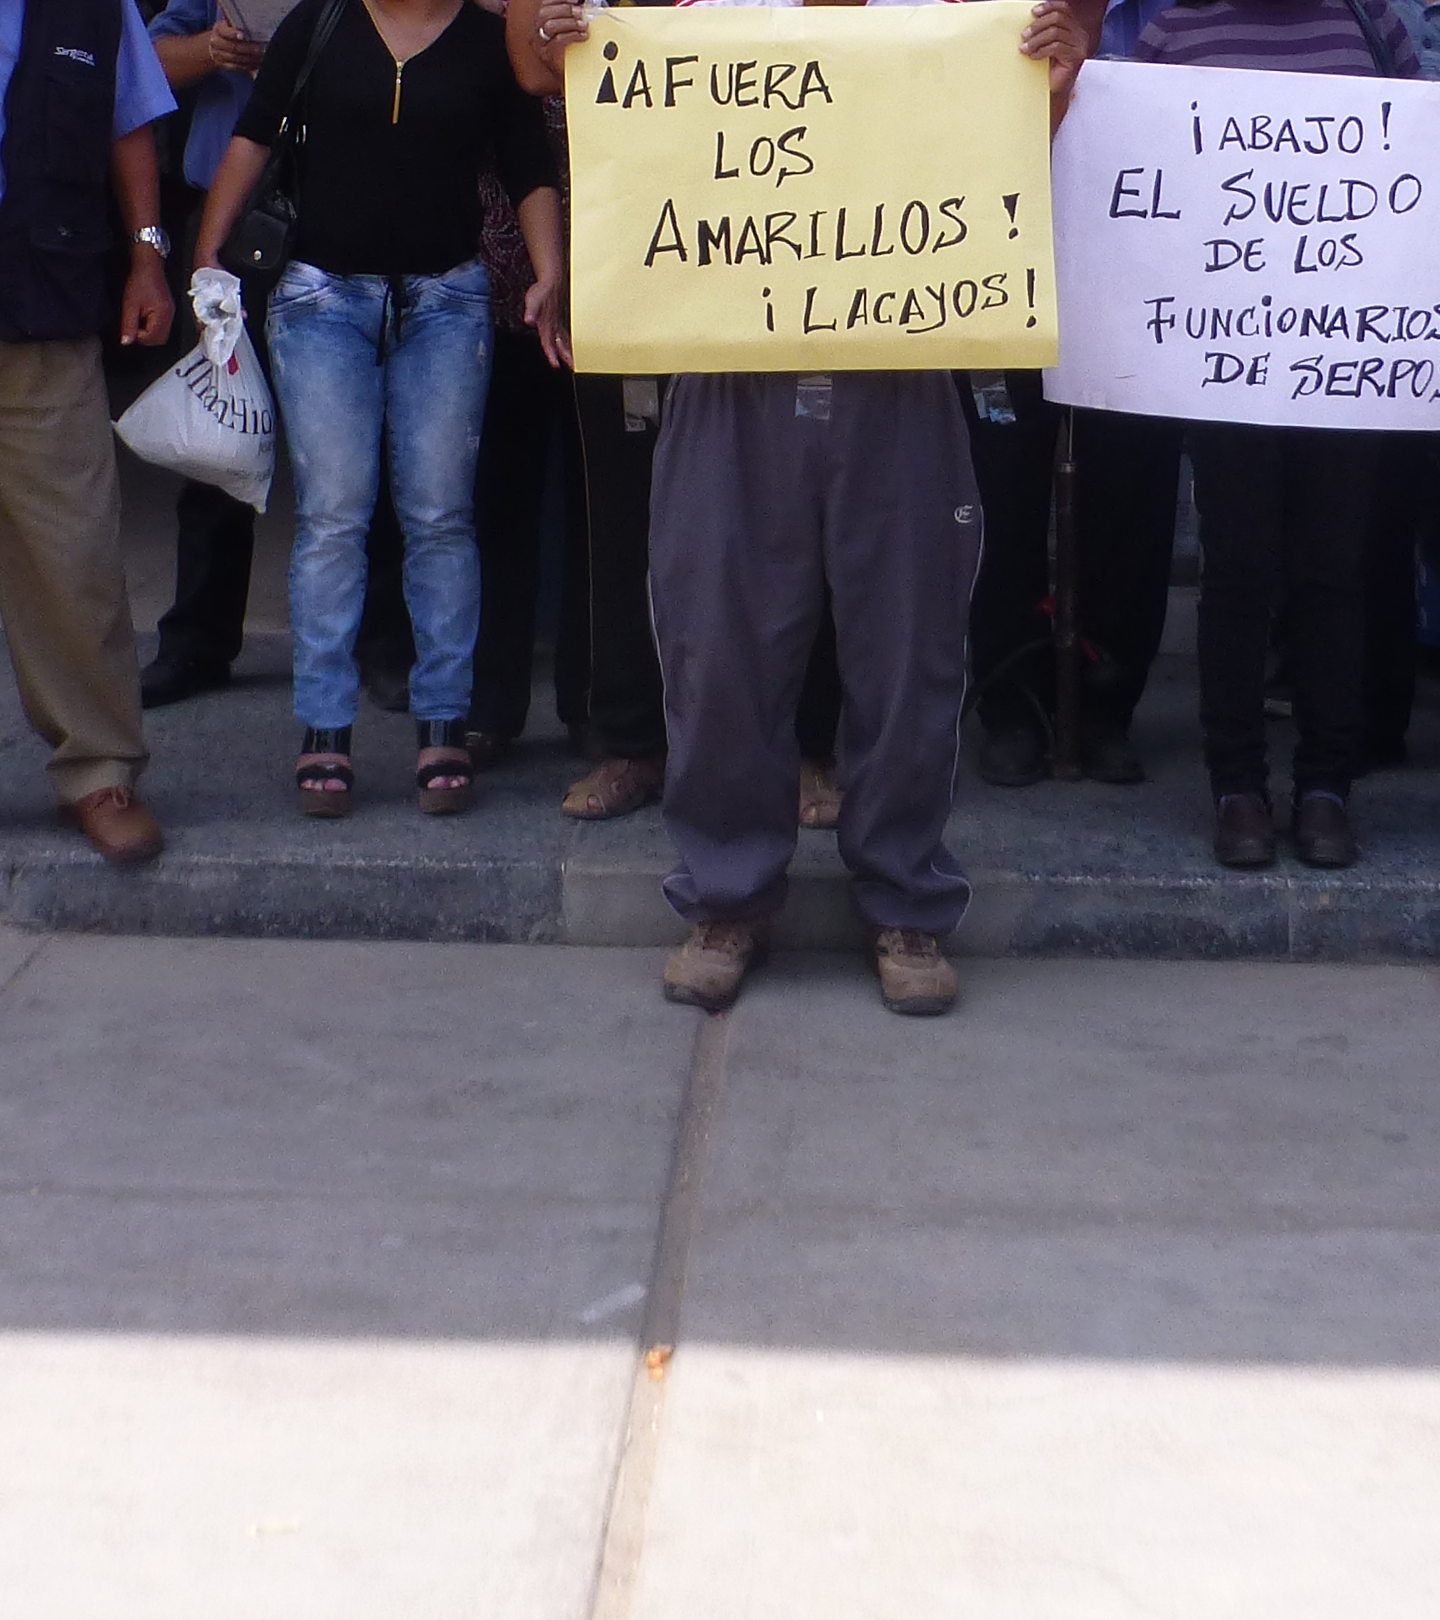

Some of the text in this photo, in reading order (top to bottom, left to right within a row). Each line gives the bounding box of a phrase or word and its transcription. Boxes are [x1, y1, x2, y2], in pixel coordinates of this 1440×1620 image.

[714, 126, 815, 188] LOS
[1109, 167, 1422, 226] EL SUELDO
[1203, 232, 1364, 274] DE LOS
[1201, 351, 1271, 388] DE
